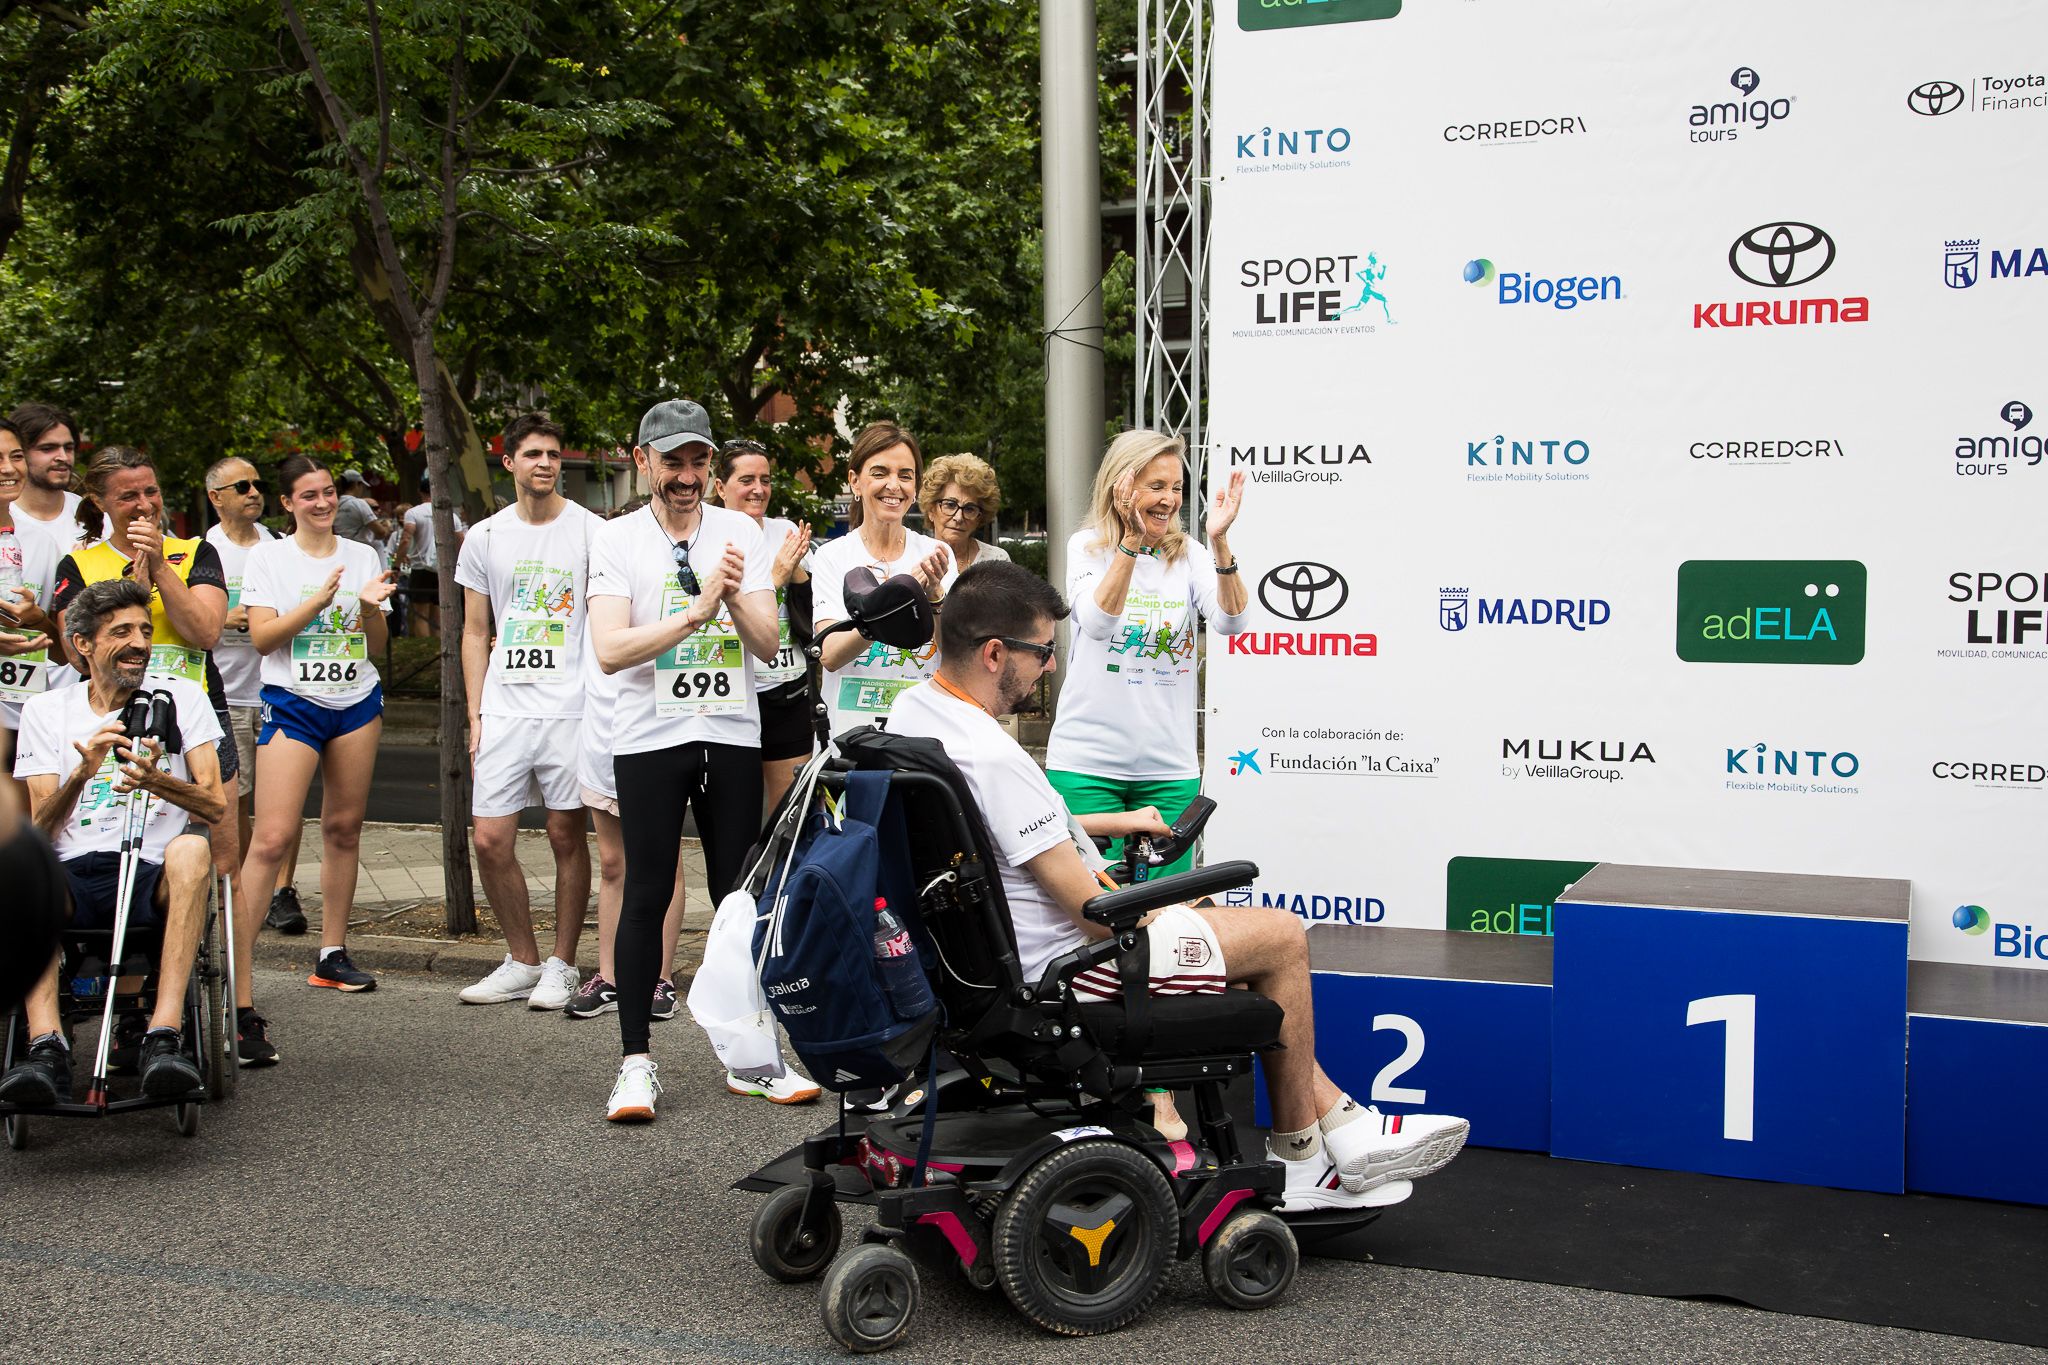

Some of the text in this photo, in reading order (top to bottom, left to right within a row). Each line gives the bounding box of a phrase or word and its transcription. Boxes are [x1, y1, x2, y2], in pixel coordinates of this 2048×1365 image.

[1982, 74, 2045, 93] Toyota
[1691, 129, 1737, 143] tours
[1235, 159, 1351, 175] Flexible Mobility Solutions
[1240, 255, 1358, 287] SPORT
[1256, 290, 1341, 324] LIFE
[1232, 330, 1274, 338] MOVILIDAD,
[1340, 324, 1376, 334] EVENTOS
[1231, 444, 1372, 466] MUKUA
[1955, 436, 2048, 466] amig
[1248, 470, 1344, 485] VelillaGroup.
[1466, 472, 1590, 483] Flexible Mobility Solutions
[1956, 462, 2008, 476] tours
[1948, 572, 2048, 602] SPO
[1478, 599, 1610, 631] MADRID
[1702, 607, 1837, 641] adELA
[1968, 609, 2048, 645] LIF
[506, 649, 556, 669] 1281
[675, 643, 725, 665] ELA
[1937, 650, 1989, 658] MOVILIDAD,
[0, 661, 37, 687] 87
[299, 663, 357, 682] 1286
[672, 672, 731, 698] 698
[857, 686, 893, 709] EL
[1262, 727, 1404, 740] Con la colaboración de:
[1270, 753, 1357, 770] Fundación
[1503, 739, 1656, 763] MUKUA
[1502, 764, 1624, 783] by VelillaGroup.
[1932, 762, 2048, 782] CORRED
[1726, 781, 1859, 794] Flexible Mobility Solutions
[1019, 811, 1057, 838] MUKUA
[1470, 903, 1555, 936] adEL
[1371, 1013, 1427, 1105] 2
[1686, 994, 1756, 1142] 1
